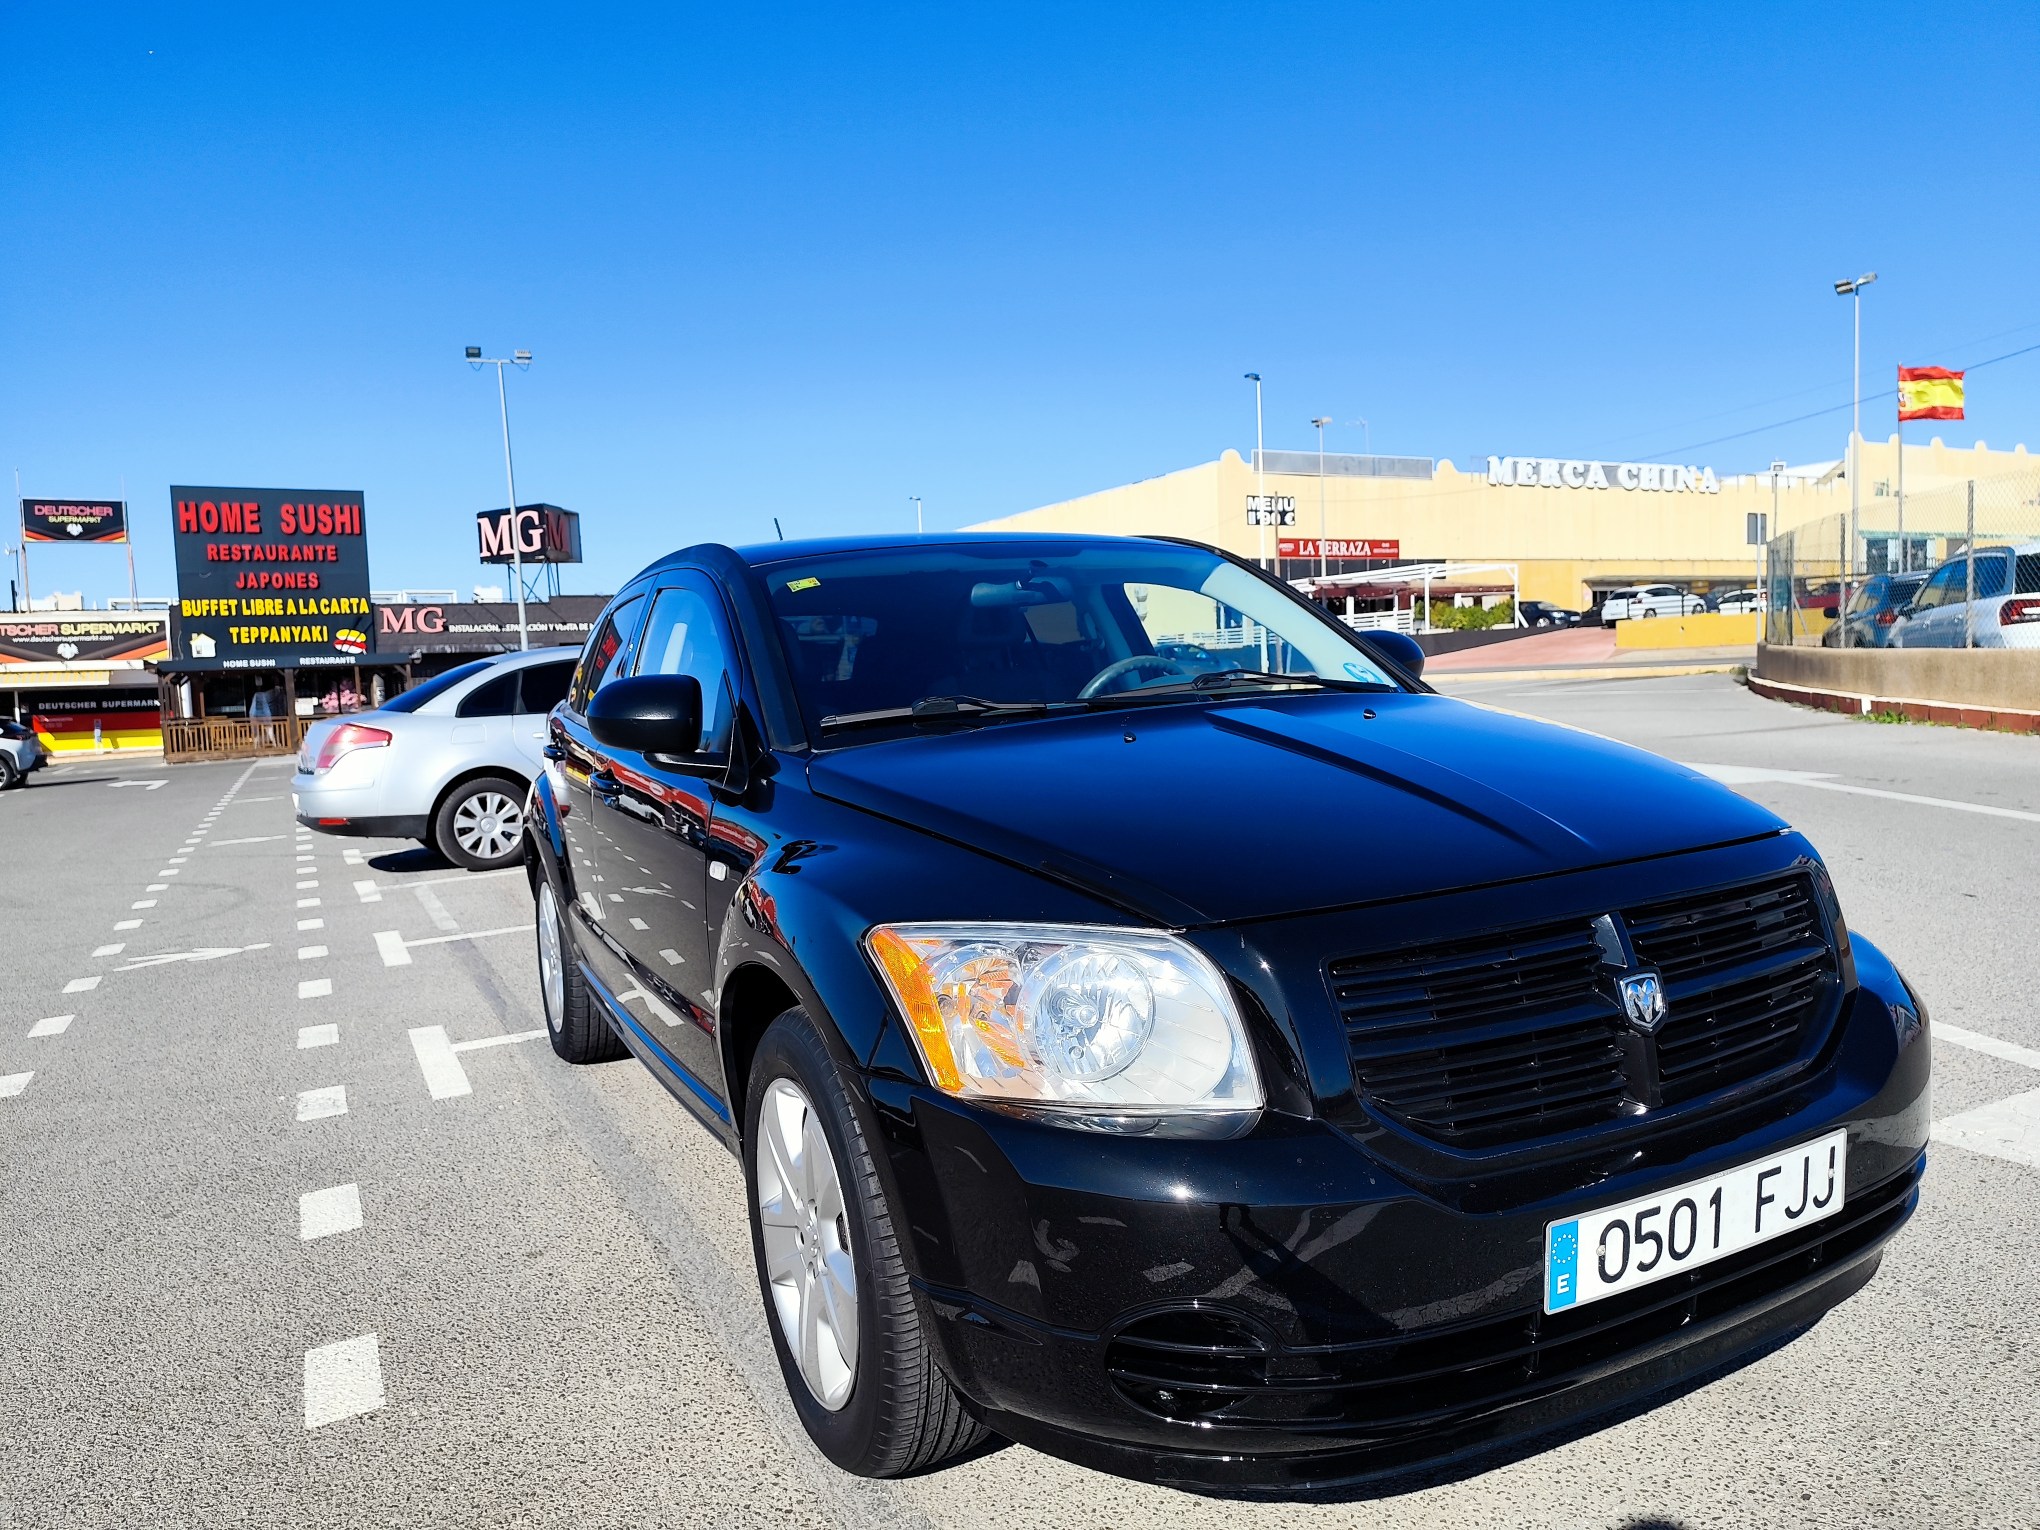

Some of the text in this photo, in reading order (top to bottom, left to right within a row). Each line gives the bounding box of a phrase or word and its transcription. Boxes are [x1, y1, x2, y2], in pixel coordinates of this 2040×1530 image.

[1487, 455, 1720, 494] MERCA CHINA
[34, 505, 113, 516] DEUTSCHER
[48, 515, 102, 523] SUPERMARKT
[178, 501, 361, 535] HOME SUSHI
[477, 510, 544, 558] MG
[207, 544, 337, 561] RESTAURANTE
[1299, 540, 1315, 556] LA
[1316, 541, 1371, 557] TERRAZA
[236, 572, 319, 589] JAPONES
[181, 597, 370, 617] BUFFET LIBRE A LA CARTA
[60, 622, 160, 635] SUPERMARKT
[379, 607, 448, 634] MG
[229, 625, 329, 644] TEPPANYAKI
[223, 659, 276, 668] HOME SUSHI
[299, 656, 356, 665] RESTAURANTE
[38, 701, 97, 710] DEUTSCHER
[1599, 1145, 1836, 1284] 0501 FJJ
[1556, 1273, 1570, 1294] E
